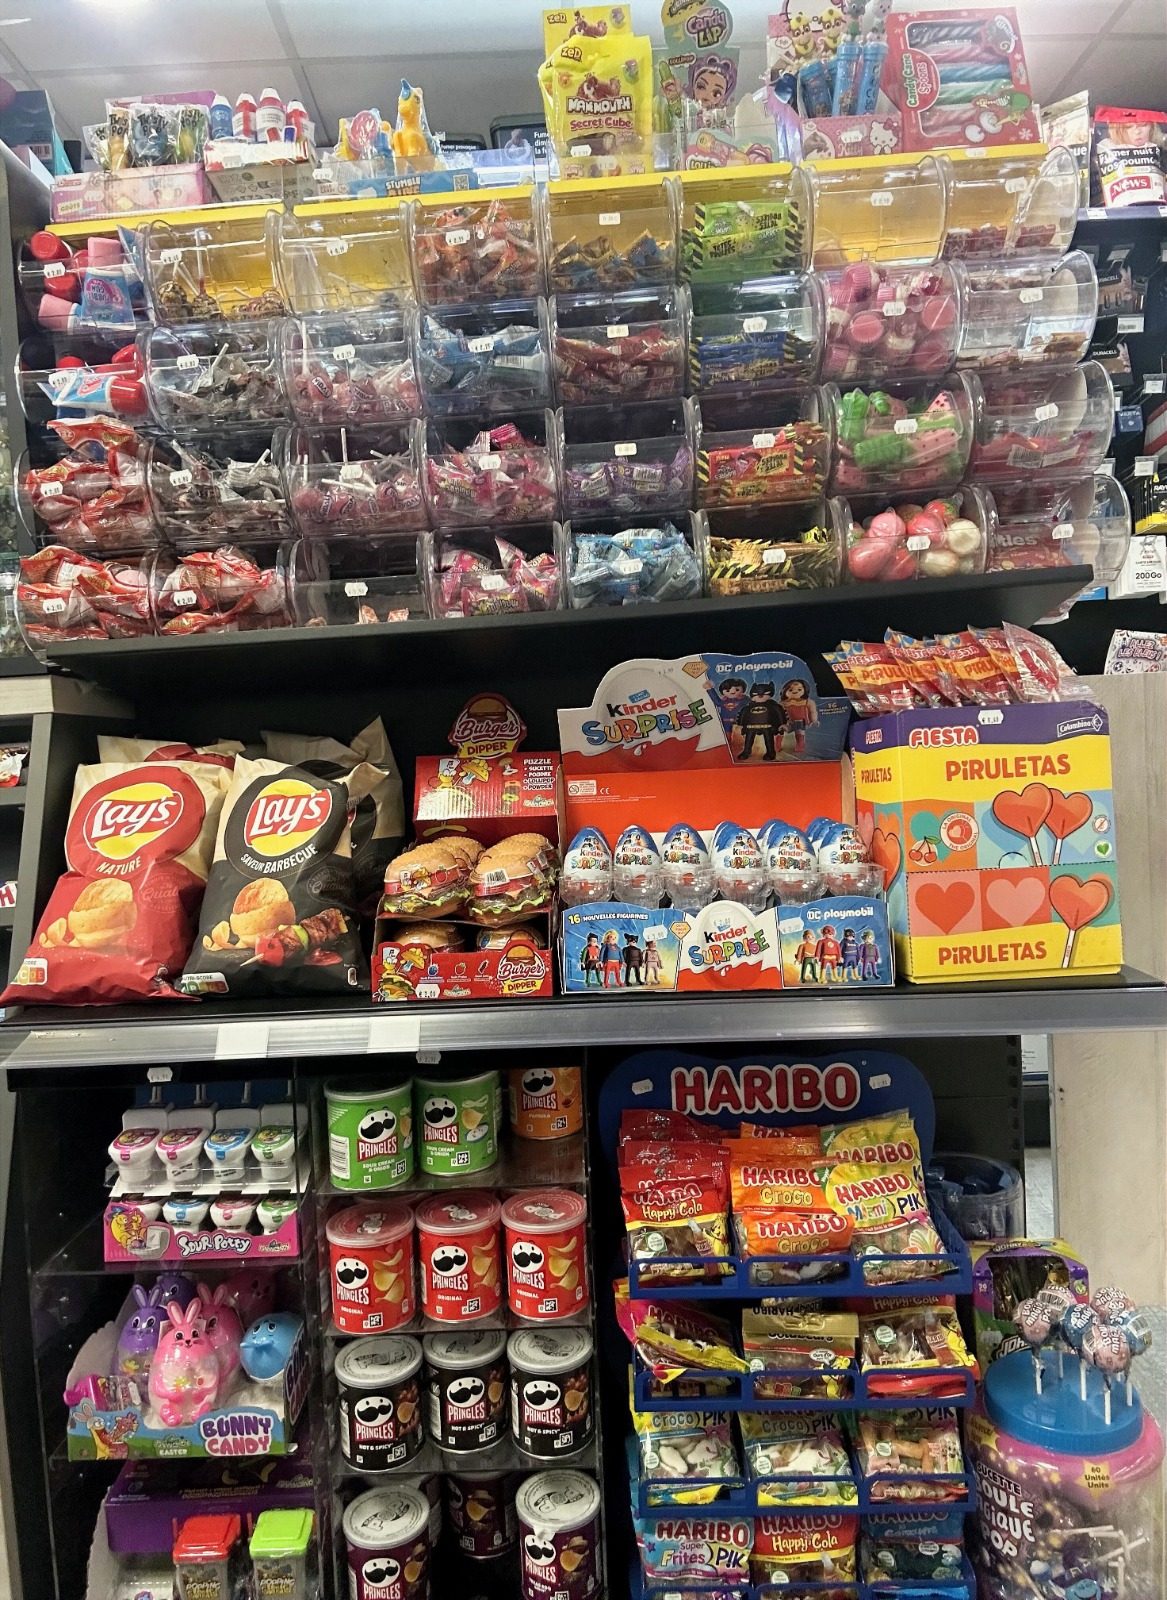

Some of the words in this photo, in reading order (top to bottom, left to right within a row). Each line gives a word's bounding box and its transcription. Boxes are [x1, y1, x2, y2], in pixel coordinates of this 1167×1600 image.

[570, 117, 602, 131] Secret
[604, 115, 633, 130] Cube
[735, 660, 794, 673] playmobil
[606, 694, 677, 718] Kinder
[455, 719, 520, 741] Burger
[581, 699, 713, 746] SURPRISE
[865, 728, 883, 744] FIESTA
[909, 725, 980, 749] FIESTA
[467, 741, 508, 756] DIPPER
[91, 795, 176, 839] Lay's
[249, 791, 328, 838] Lay's
[96, 856, 143, 875] NATURE
[240, 853, 265, 873] SAVEUR
[262, 843, 319, 875] BARBECUE
[568, 914, 581, 924] 16
[583, 913, 616, 922] NOUVELLES
[617, 913, 649, 921] FIGURINES
[823, 906, 874, 920] playmobil
[703, 925, 748, 943] Kinder
[688, 928, 771, 967] SURPRISE
[498, 962, 545, 980] Burger
[507, 980, 537, 992] DIPPER
[674, 1065, 858, 1113] HARIBO
[523, 1093, 557, 1110] PRINGLES
[424, 1125, 457, 1143] PRINGLES
[359, 1137, 397, 1160] PRINGLES
[761, 1188, 813, 1206] Croco
[835, 1173, 911, 1204] HARIBO
[642, 1205, 675, 1222] Happy
[679, 1202, 703, 1219] Cola
[432, 1273, 469, 1291] PRINGLES
[512, 1272, 545, 1290] PRINGLES
[336, 1282, 370, 1304] PRINGLES
[437, 1294, 463, 1302] ORIGINAL
[340, 1306, 364, 1315] ORIGINAL
[448, 1404, 485, 1421] PRINGLES
[525, 1407, 561, 1425] PRINGLES
[202, 1415, 272, 1439] BUNNY
[355, 1423, 394, 1440] PRINGLES
[468, 1423, 484, 1431] SPICY
[159, 1448, 188, 1456] EASTER
[206, 1436, 271, 1456] CANDY
[377, 1443, 393, 1451] SPICY
[657, 1520, 750, 1546] HARIBO
[772, 1536, 808, 1553] Happy
[813, 1531, 838, 1550] Cola
[680, 1541, 705, 1552] Super
[661, 1552, 706, 1567] Frites
[525, 1555, 556, 1583] PRINGLES
[363, 1582, 401, 1600] PRINGLES
